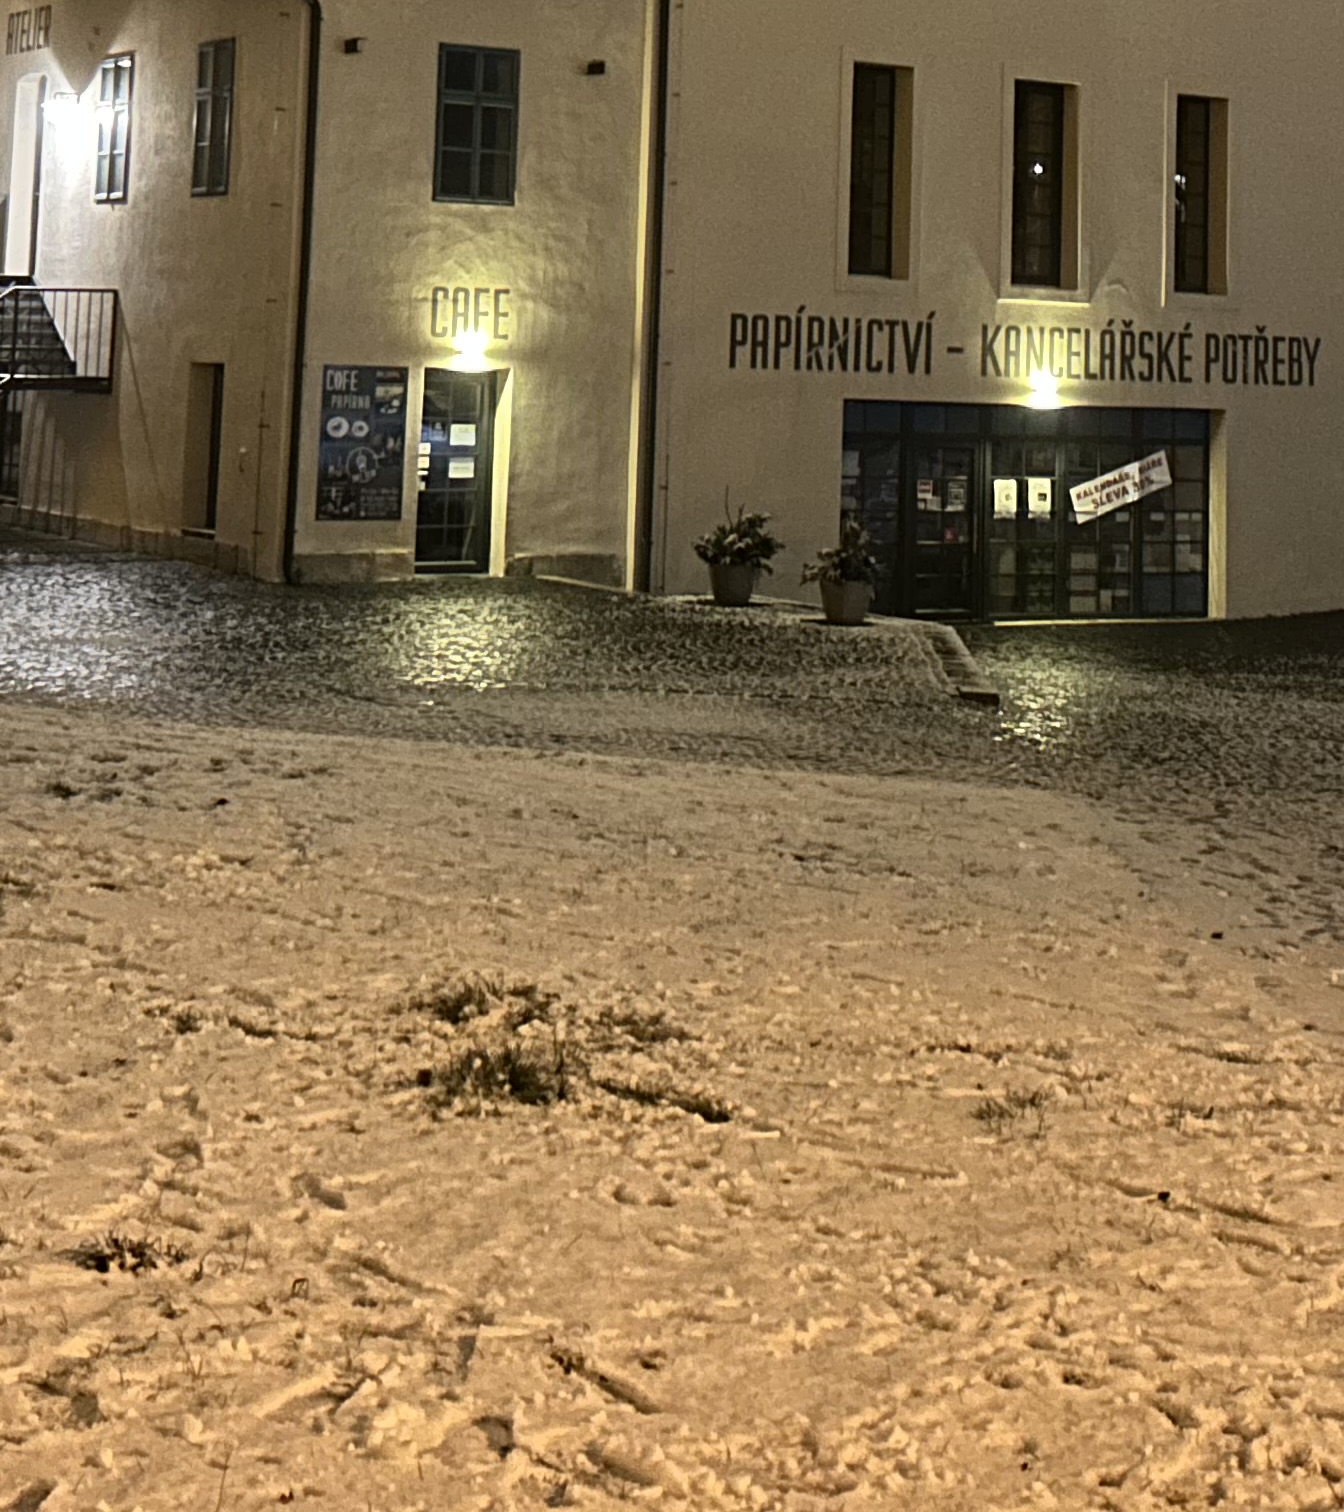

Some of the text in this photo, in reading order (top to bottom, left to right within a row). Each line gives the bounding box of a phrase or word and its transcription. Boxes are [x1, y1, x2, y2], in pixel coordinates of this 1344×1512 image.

[6, 4, 52, 56] ATELIER
[431, 286, 510, 340] CAFE
[729, 304, 936, 375] PAPÍRNICTVÍ
[981, 319, 1193, 384] KANCELÁŘSKÉ
[1205, 325, 1321, 386] POTŘEBY
[1091, 486, 1129, 509] SLEVA
